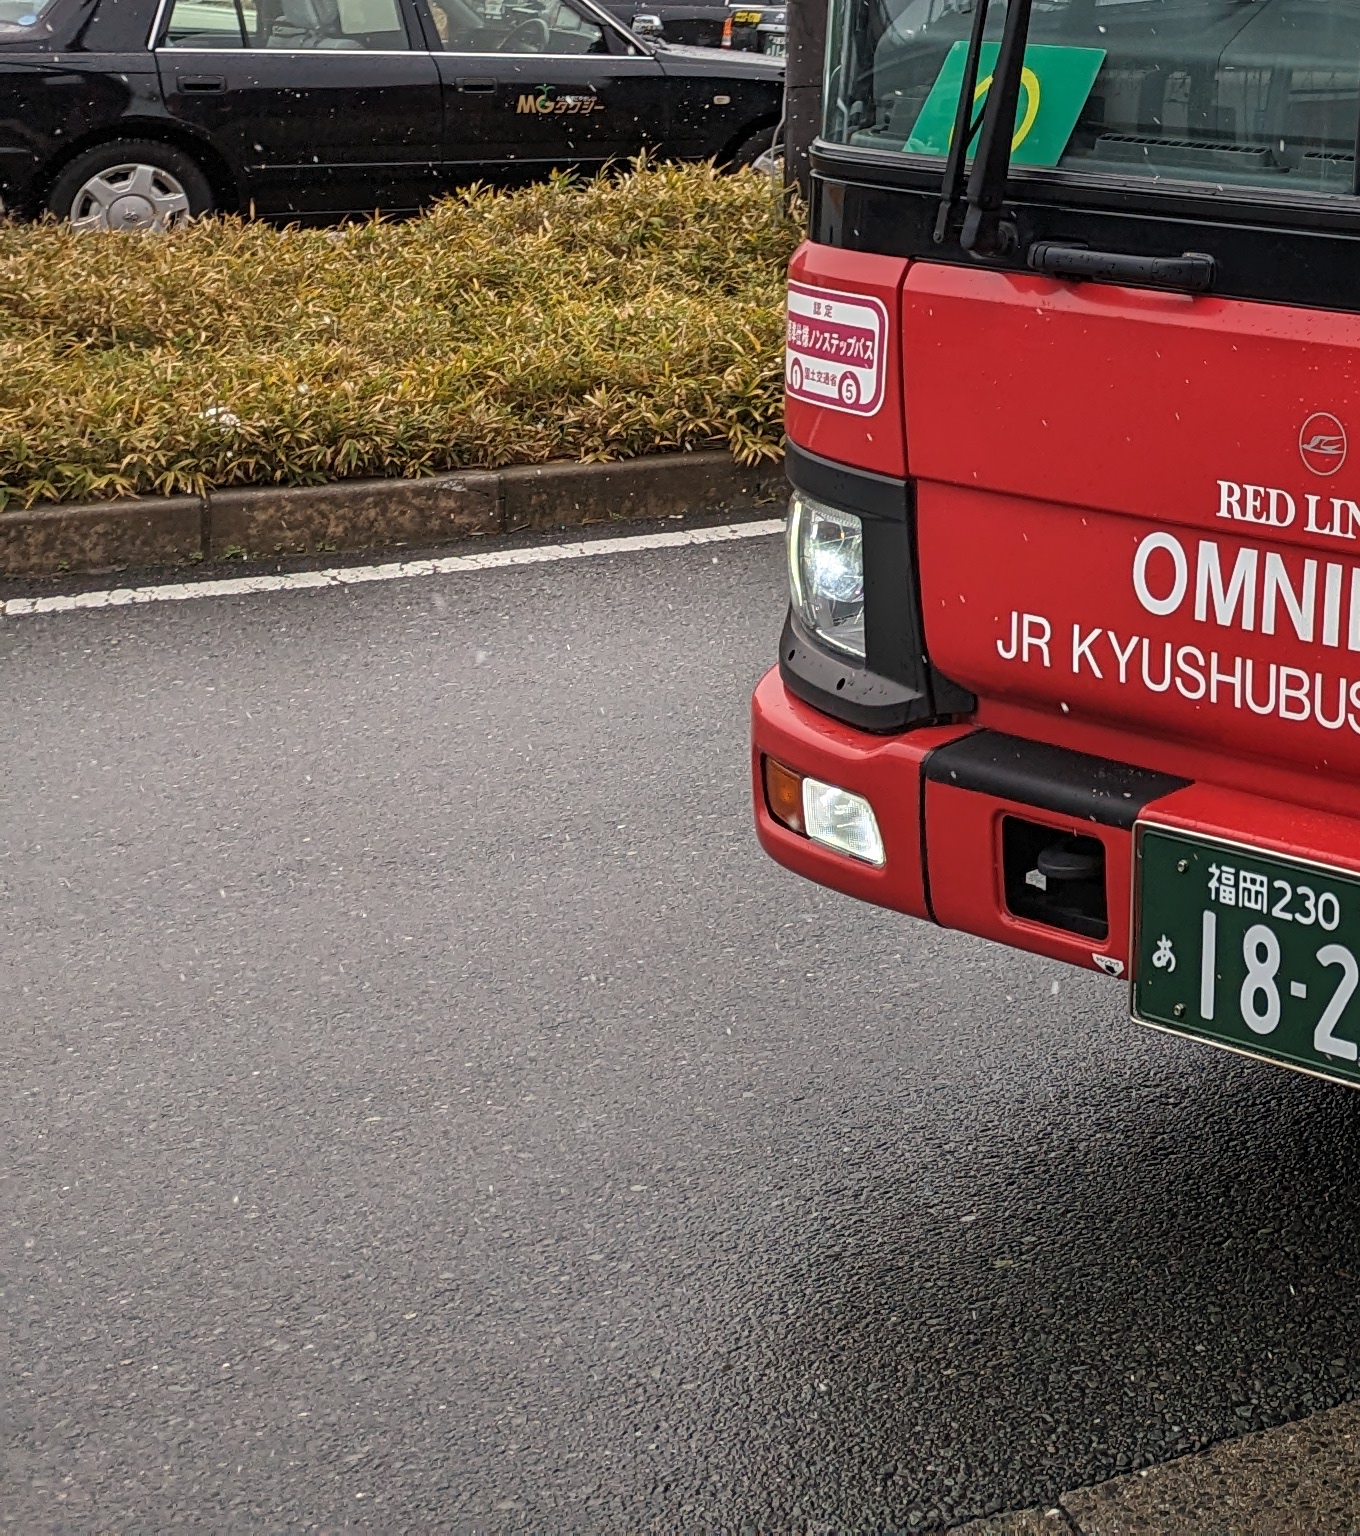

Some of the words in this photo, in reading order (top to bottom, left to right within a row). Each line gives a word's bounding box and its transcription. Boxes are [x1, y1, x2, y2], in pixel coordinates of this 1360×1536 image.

[813, 301, 833, 319] 認定
[794, 369, 799, 384] 1
[804, 367, 838, 387] 国土交通省
[845, 383, 854, 400] 5
[1215, 480, 1296, 529] RED
[996, 611, 1052, 668] JR
[1151, 934, 1176, 973] あ
